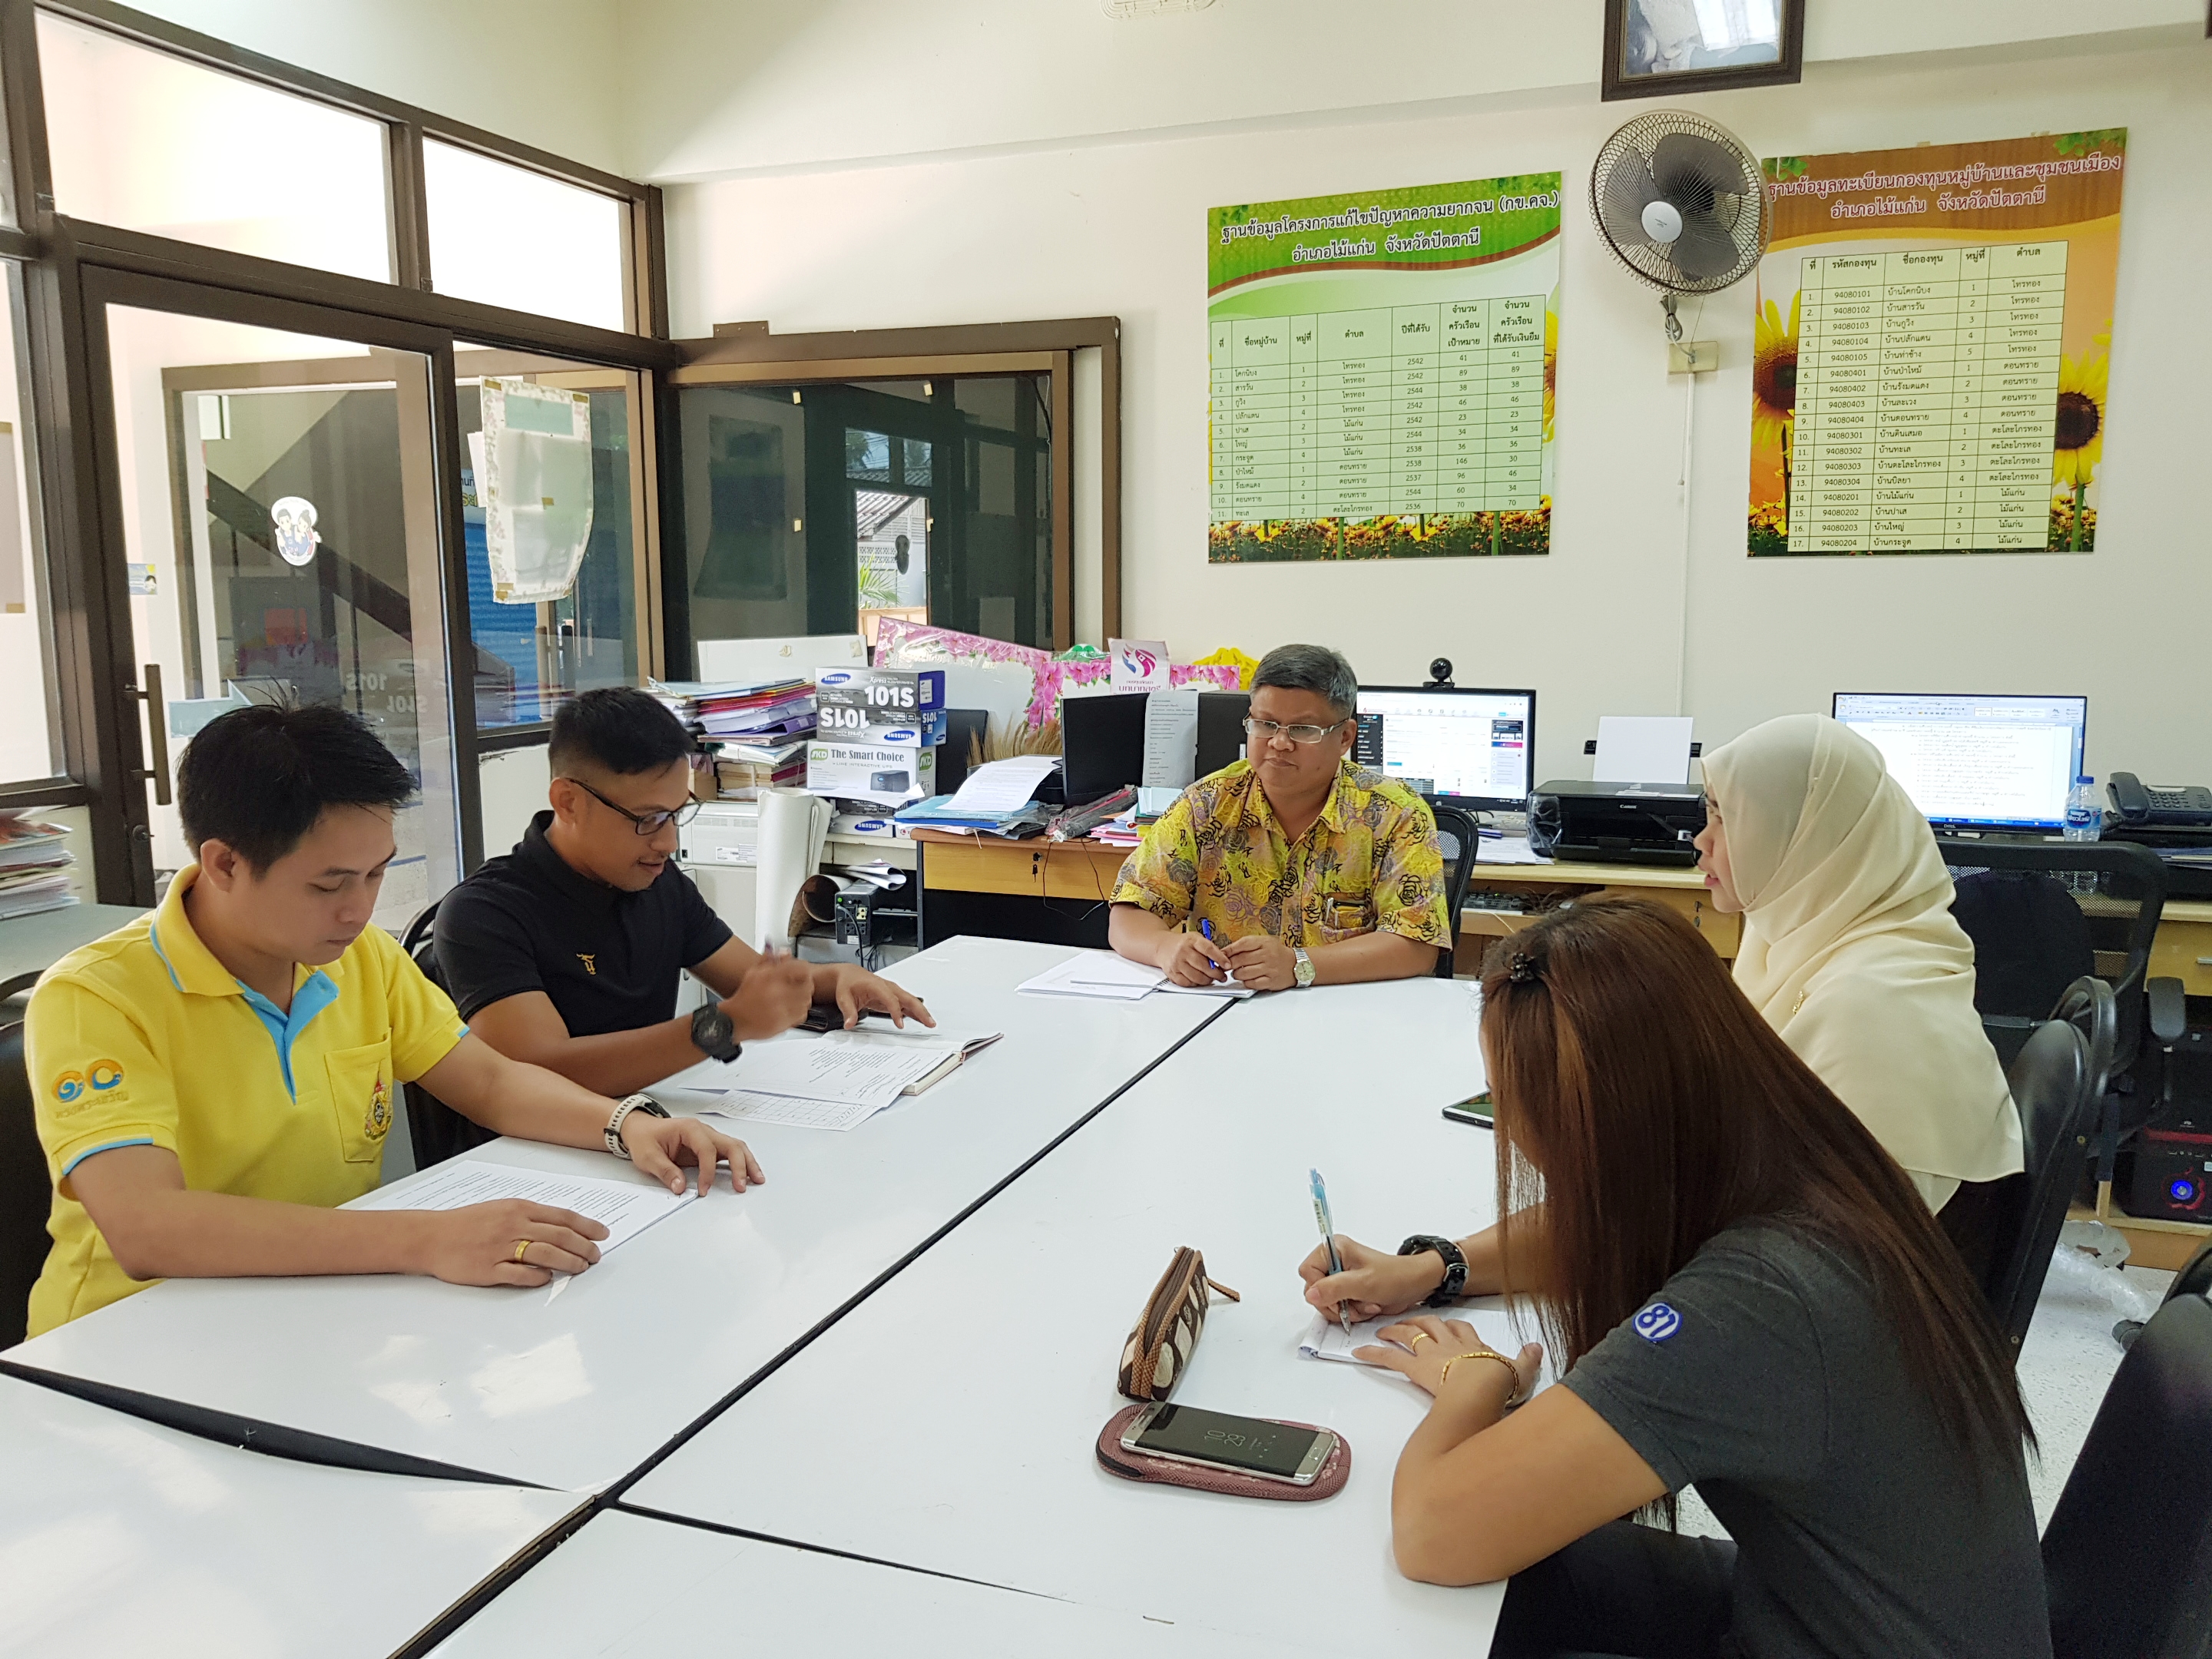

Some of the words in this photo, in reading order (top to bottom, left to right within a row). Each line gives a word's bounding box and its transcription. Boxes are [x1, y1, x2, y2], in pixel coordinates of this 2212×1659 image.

[1832, 197, 1926, 218] อำเภอไม้แก่น
[1938, 186, 2045, 210] จังหวัดปัตตานี
[1221, 200, 1492, 243] ฐานข้อมูลโครงการแก้ไขปัญหาความยากจน
[1499, 191, 1558, 211] (กข.คจ.)
[1293, 240, 1375, 261] อำเภอไม้แก่น
[1386, 227, 1479, 253] จังหวัดปัตตานี
[1965, 247, 1986, 263] หมู่ที่
[2015, 246, 2041, 257] ตำบล
[1808, 257, 1816, 270] ที่
[1831, 257, 1877, 270] รหัสกองทุน
[1901, 252, 1944, 267] ชื่อกองทุน
[1833, 290, 1871, 300] 94080101
[1451, 303, 1478, 314] จำนวน
[1503, 299, 1531, 310] จำนวน
[1833, 305, 1871, 316] 94080102
[1448, 319, 1481, 330] ครัวเรือน
[1500, 314, 1533, 327] ครัวเรือน
[1832, 320, 1870, 331] 94080103
[1343, 328, 1365, 339] ตำบล
[1400, 321, 1431, 335] ปีที่ได้รับ
[1243, 334, 1278, 349] ชื่อหมู่บ้าน
[1295, 329, 1312, 345] หมู่ที่
[1447, 336, 1481, 347] เป้าหมาย
[1492, 330, 1540, 344] ที่ได้รับเงินยืม
[1831, 336, 1869, 346] 94080104
[1406, 356, 1424, 366] 2542
[1458, 353, 1468, 362] 41
[1510, 349, 1520, 359] 41
[1830, 353, 1869, 363] 94080105
[1406, 371, 1424, 381] 2542
[1458, 368, 1469, 377] 89
[1510, 365, 1521, 373] 89
[1829, 368, 1866, 378] 94080401
[1406, 386, 1423, 396] 2544
[1458, 383, 1468, 392] 38
[1510, 379, 1520, 389] 38
[1828, 384, 1867, 393] 94080402
[1406, 401, 1423, 410] 2542
[1458, 398, 1468, 406] 46
[1509, 395, 1520, 403] 46
[1827, 399, 1866, 409] 94080403
[1406, 416, 1423, 425] 2542
[1457, 412, 1468, 422] 23
[1509, 409, 1519, 419] 23
[1826, 415, 1865, 425] 94080404
[1405, 430, 1423, 439] 2544
[1457, 427, 1467, 436] 34
[1509, 424, 1519, 433] 34
[1826, 431, 1863, 440] 94080301
[1405, 445, 1423, 453] 2538
[1456, 442, 1467, 451] 36
[1508, 439, 1518, 449] 36
[1825, 446, 1863, 455] 94080302
[1405, 459, 1422, 468] 2538
[1455, 456, 1469, 465] 146
[1508, 454, 1518, 463] 30
[1824, 462, 1862, 471] 94080303
[1405, 473, 1422, 482] 2537
[1456, 472, 1466, 480] 96
[1508, 469, 1518, 477] 46
[1823, 477, 1861, 486] 94080304
[1404, 488, 1422, 496] 2544
[1455, 485, 1466, 494] 60
[1507, 484, 1517, 492] 34
[1823, 492, 1859, 502] 94080201
[1404, 502, 1422, 511] 2536
[1455, 500, 1465, 508] 70
[1507, 498, 1518, 507] 70
[1822, 508, 1859, 517] 94080202
[1821, 523, 1859, 532] 94080203
[1820, 538, 1858, 548] 94080204
[864, 686, 914, 707] 101S
[820, 707, 870, 729] 101S
[831, 749, 847, 759] The
[849, 750, 873, 760] Smart
[876, 752, 905, 763] Choice
[1637, 1305, 1676, 1337] 81
